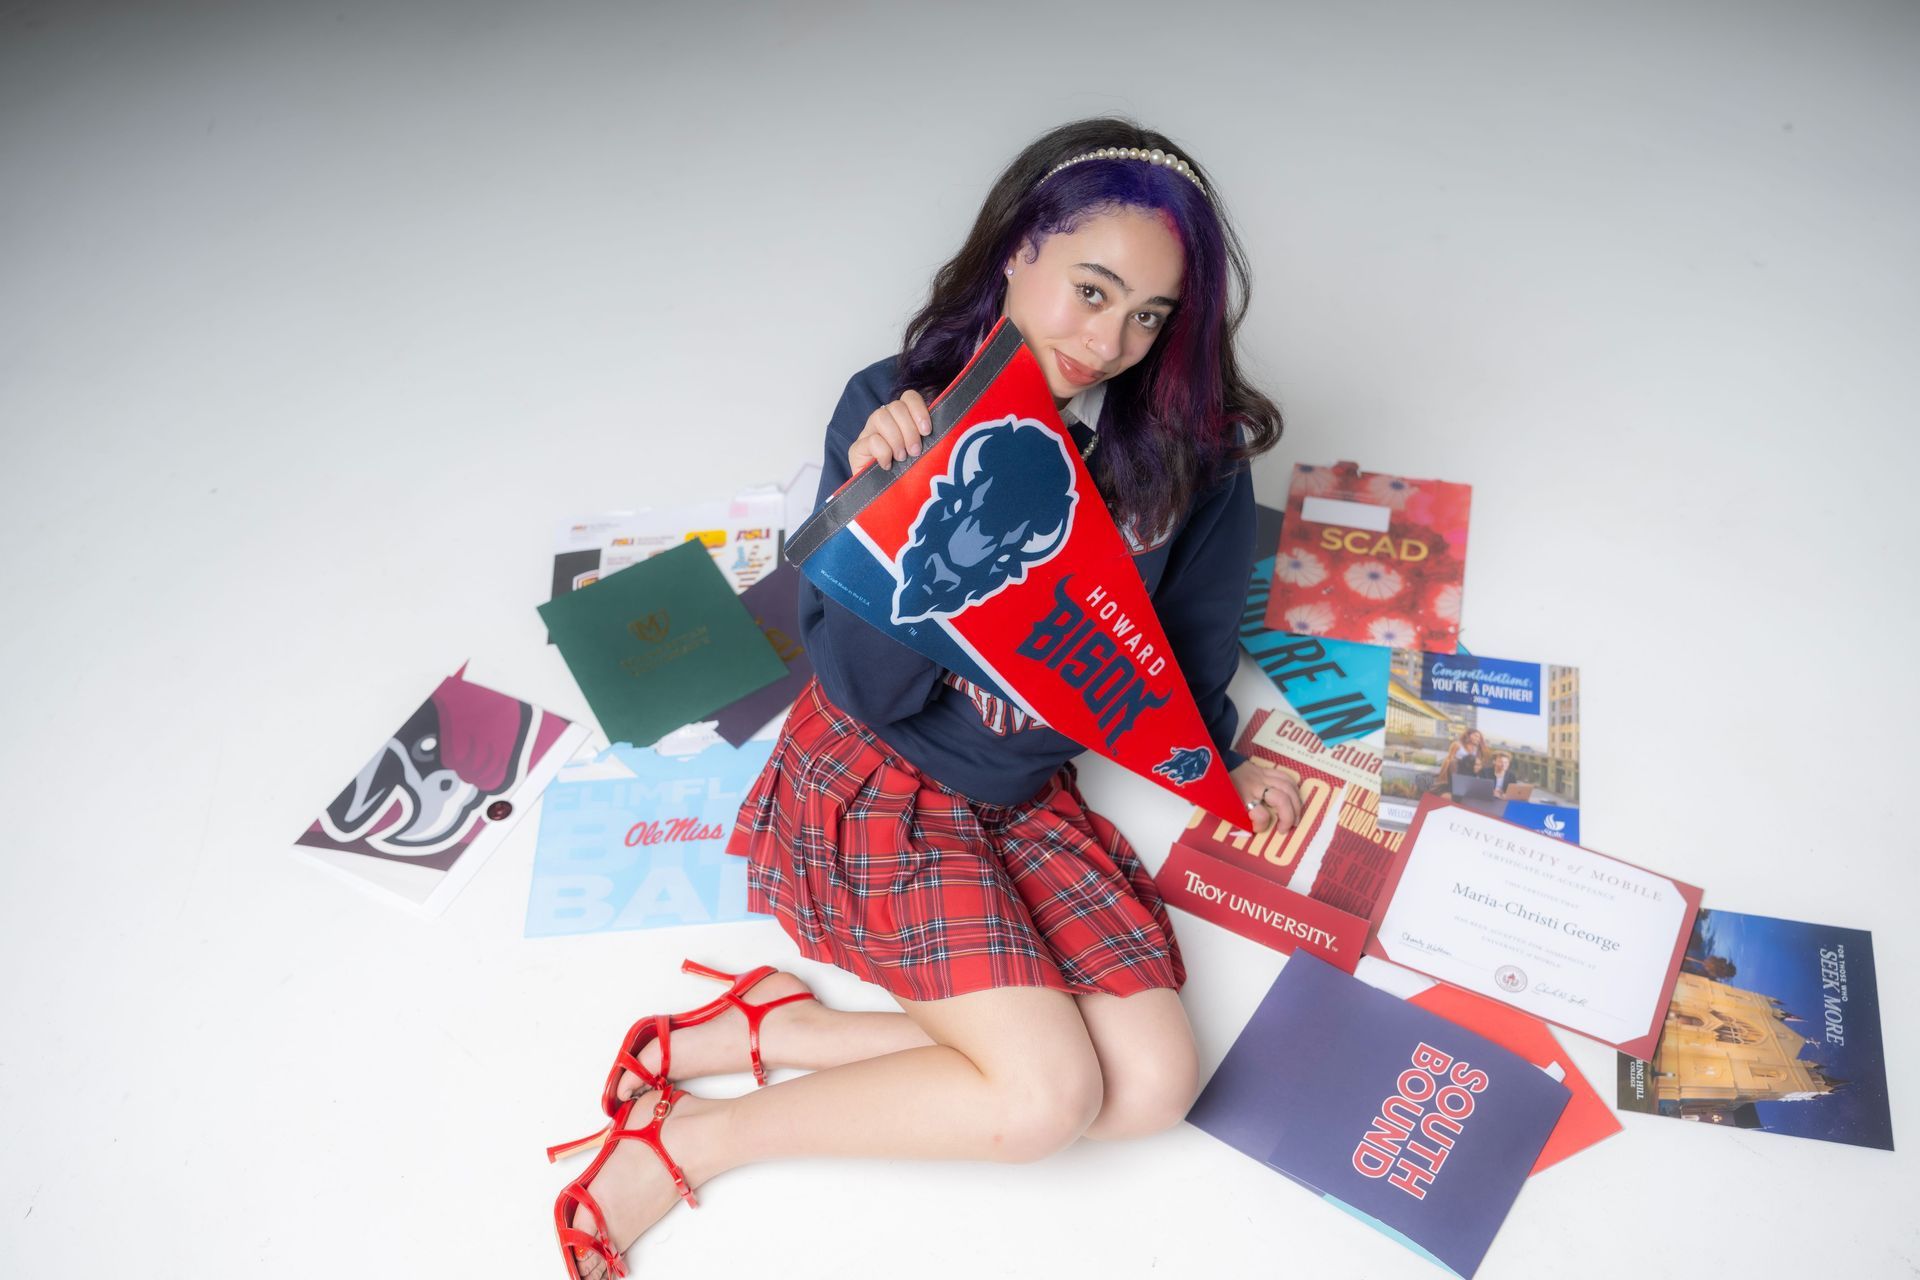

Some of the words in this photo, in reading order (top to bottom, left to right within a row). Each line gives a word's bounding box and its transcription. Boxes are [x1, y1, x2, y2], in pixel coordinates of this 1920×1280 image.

[735, 528, 770, 541] ASU
[1320, 527, 1429, 561] SCAD
[908, 627, 918, 637] TM
[1086, 586, 1166, 677] HOWARD
[1015, 573, 1174, 748] BISON
[1294, 692, 1386, 742] IN
[1431, 677, 1469, 694] YOU'RE
[1471, 682, 1480, 695] A
[1482, 684, 1533, 703] PANTHER!
[1276, 719, 1382, 776] Congatula
[624, 821, 663, 849] Ole
[663, 816, 727, 843] Miss
[1447, 820, 1560, 868] UNIVERSITY
[1565, 860, 1585, 877] of
[1589, 868, 1665, 904] MOBILE
[526, 863, 752, 937] BA
[1229, 894, 1336, 949] UNIVERSITY
[1450, 880, 1561, 931] Maria-Christi
[1559, 919, 1624, 956] George
[1820, 947, 1840, 995] SEEK
[1823, 994, 1844, 1047] MORE
[1352, 1041, 1454, 1179] BOUND
[1388, 1061, 1489, 1200] SOUTH
